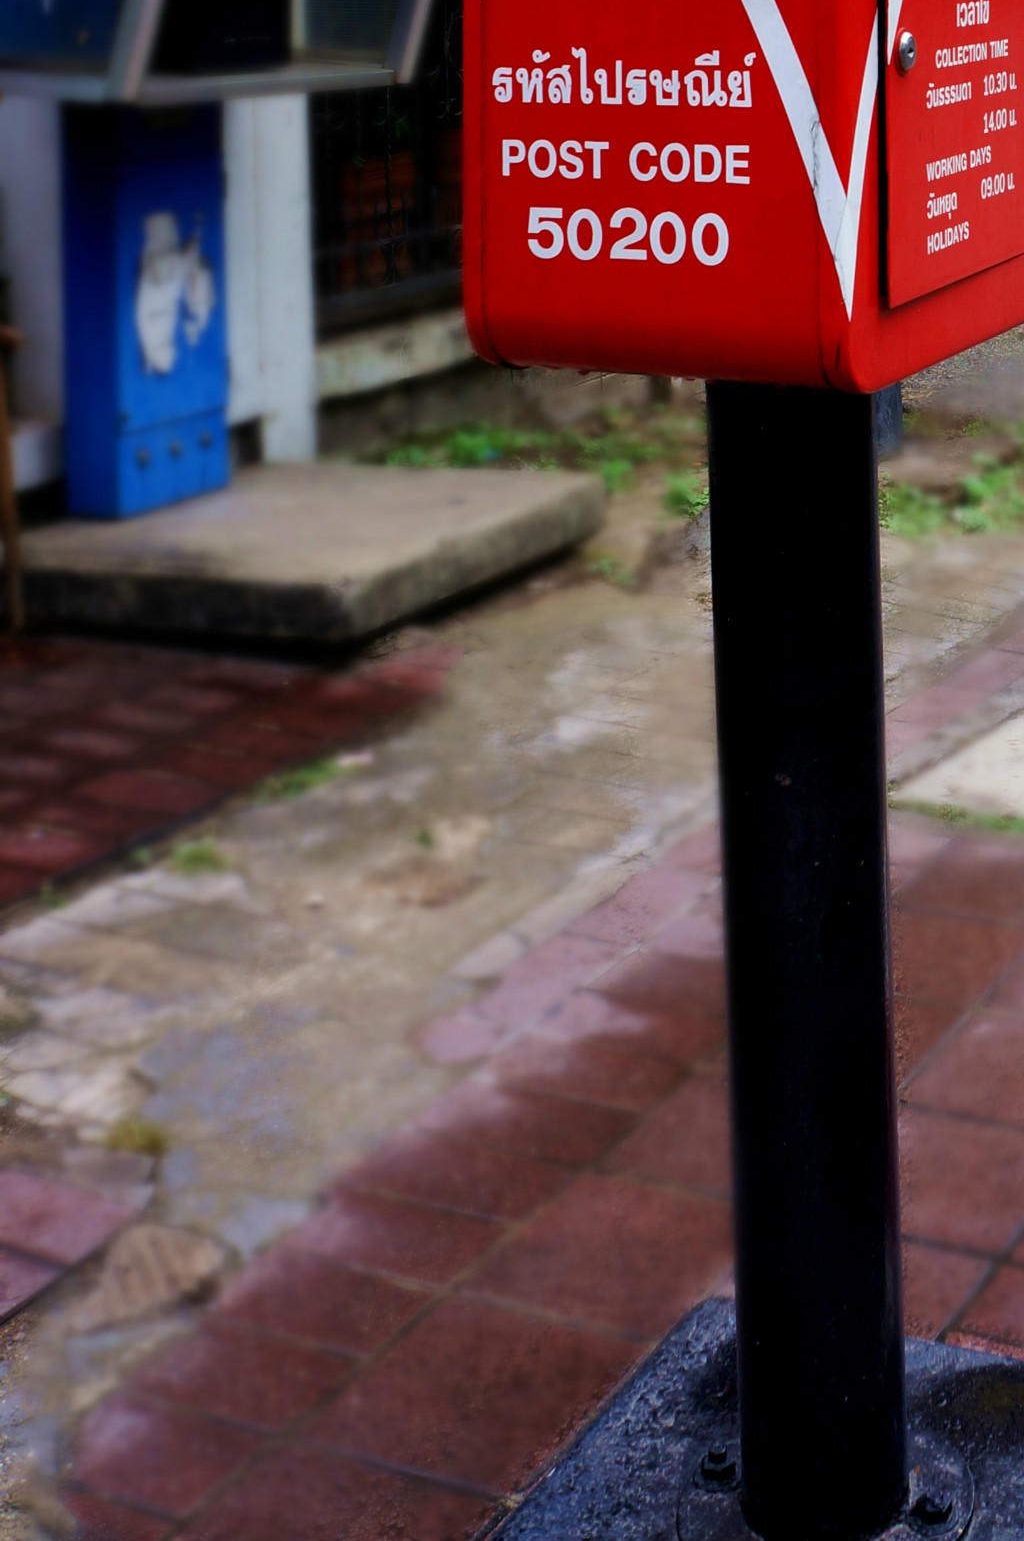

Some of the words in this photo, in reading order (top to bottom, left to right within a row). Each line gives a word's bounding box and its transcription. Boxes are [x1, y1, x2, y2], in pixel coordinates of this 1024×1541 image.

[935, 42, 988, 69] COLLECTION
[989, 38, 1009, 59] TIME
[492, 46, 757, 108] รหัสไปรษณีย์
[926, 81, 972, 109] วันธรรมดา
[983, 71, 1008, 96] 10.30
[983, 108, 1008, 134] 14.00
[502, 138, 610, 179] POST
[629, 141, 751, 185] CODE
[926, 152, 968, 182] WORKING
[969, 145, 992, 169] DAYS
[926, 191, 958, 220] วันหยุด
[980, 172, 1006, 200] 09.00
[527, 206, 730, 266] 50200
[927, 221, 970, 255] HOLIDAYS
